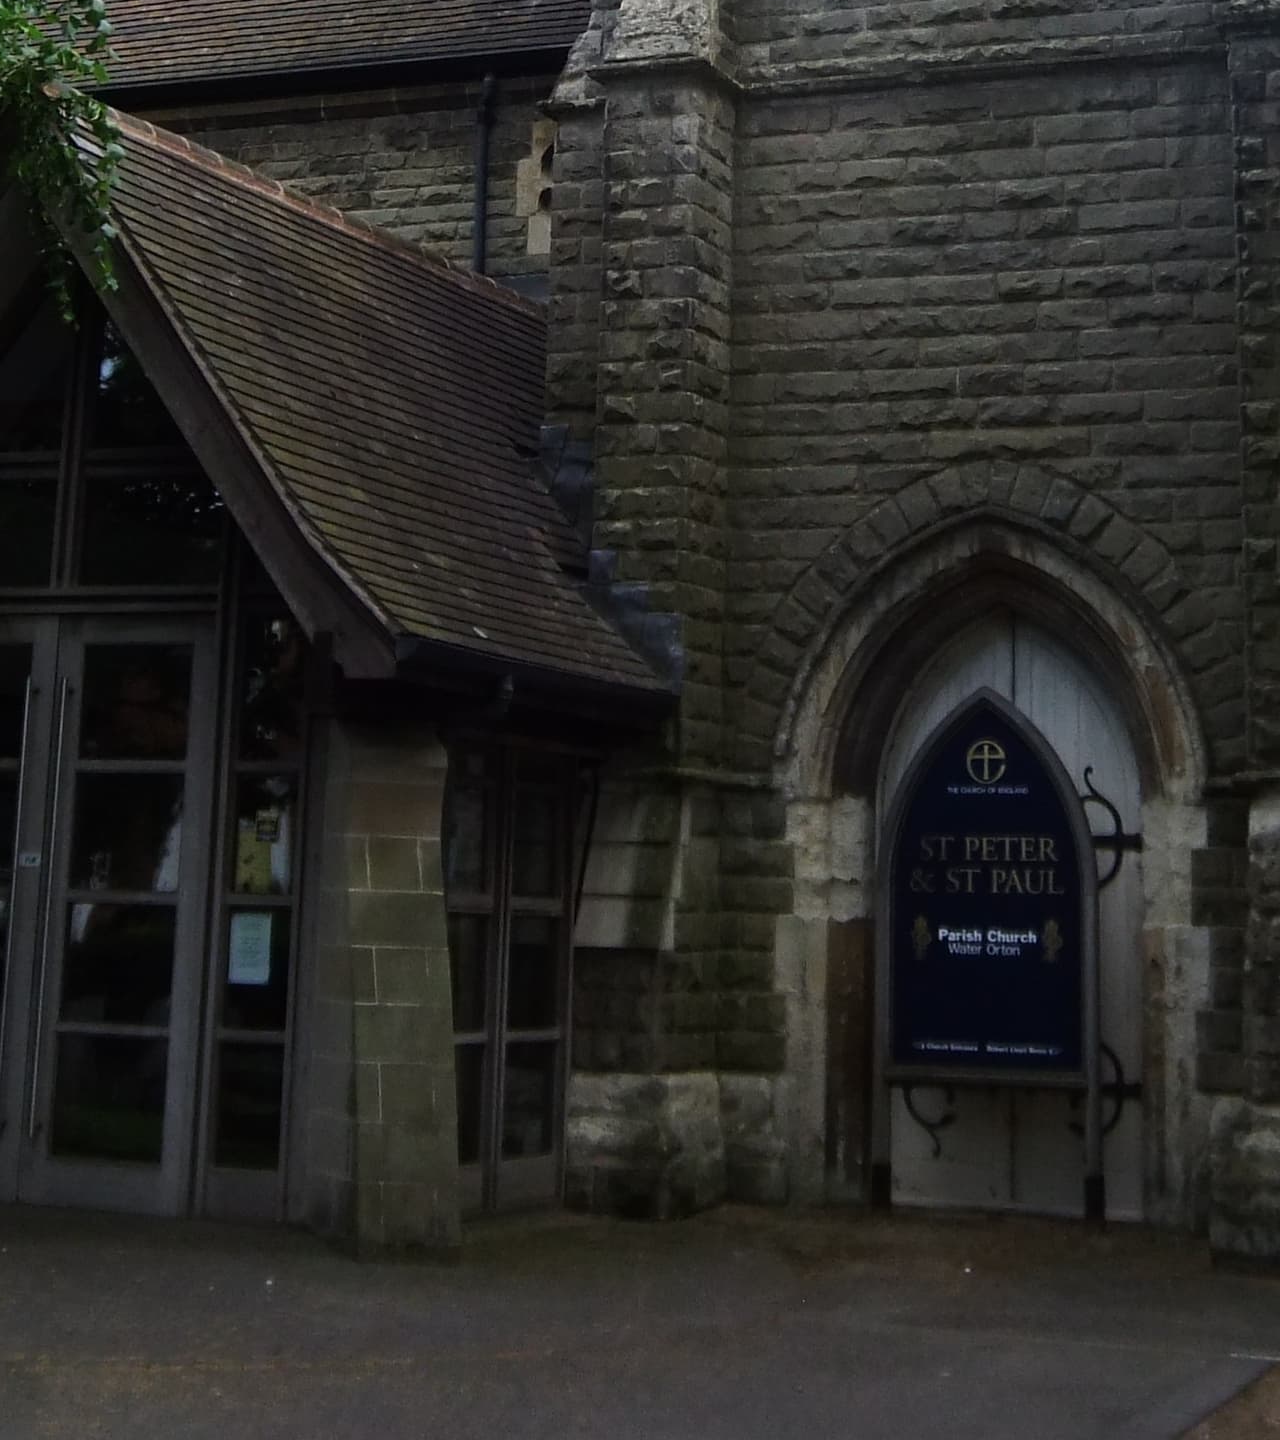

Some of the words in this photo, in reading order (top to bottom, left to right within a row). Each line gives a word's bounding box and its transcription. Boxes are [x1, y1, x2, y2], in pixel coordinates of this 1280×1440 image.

[920, 836, 955, 862] ST
[964, 836, 1059, 862] PETER
[910, 868, 936, 894] &
[945, 868, 982, 894] ST
[991, 868, 1065, 895] PAUL
[938, 928, 983, 942] Parish
[987, 929, 1037, 945] Church
[948, 942, 982, 956] Water
[986, 943, 1020, 957] Orton
